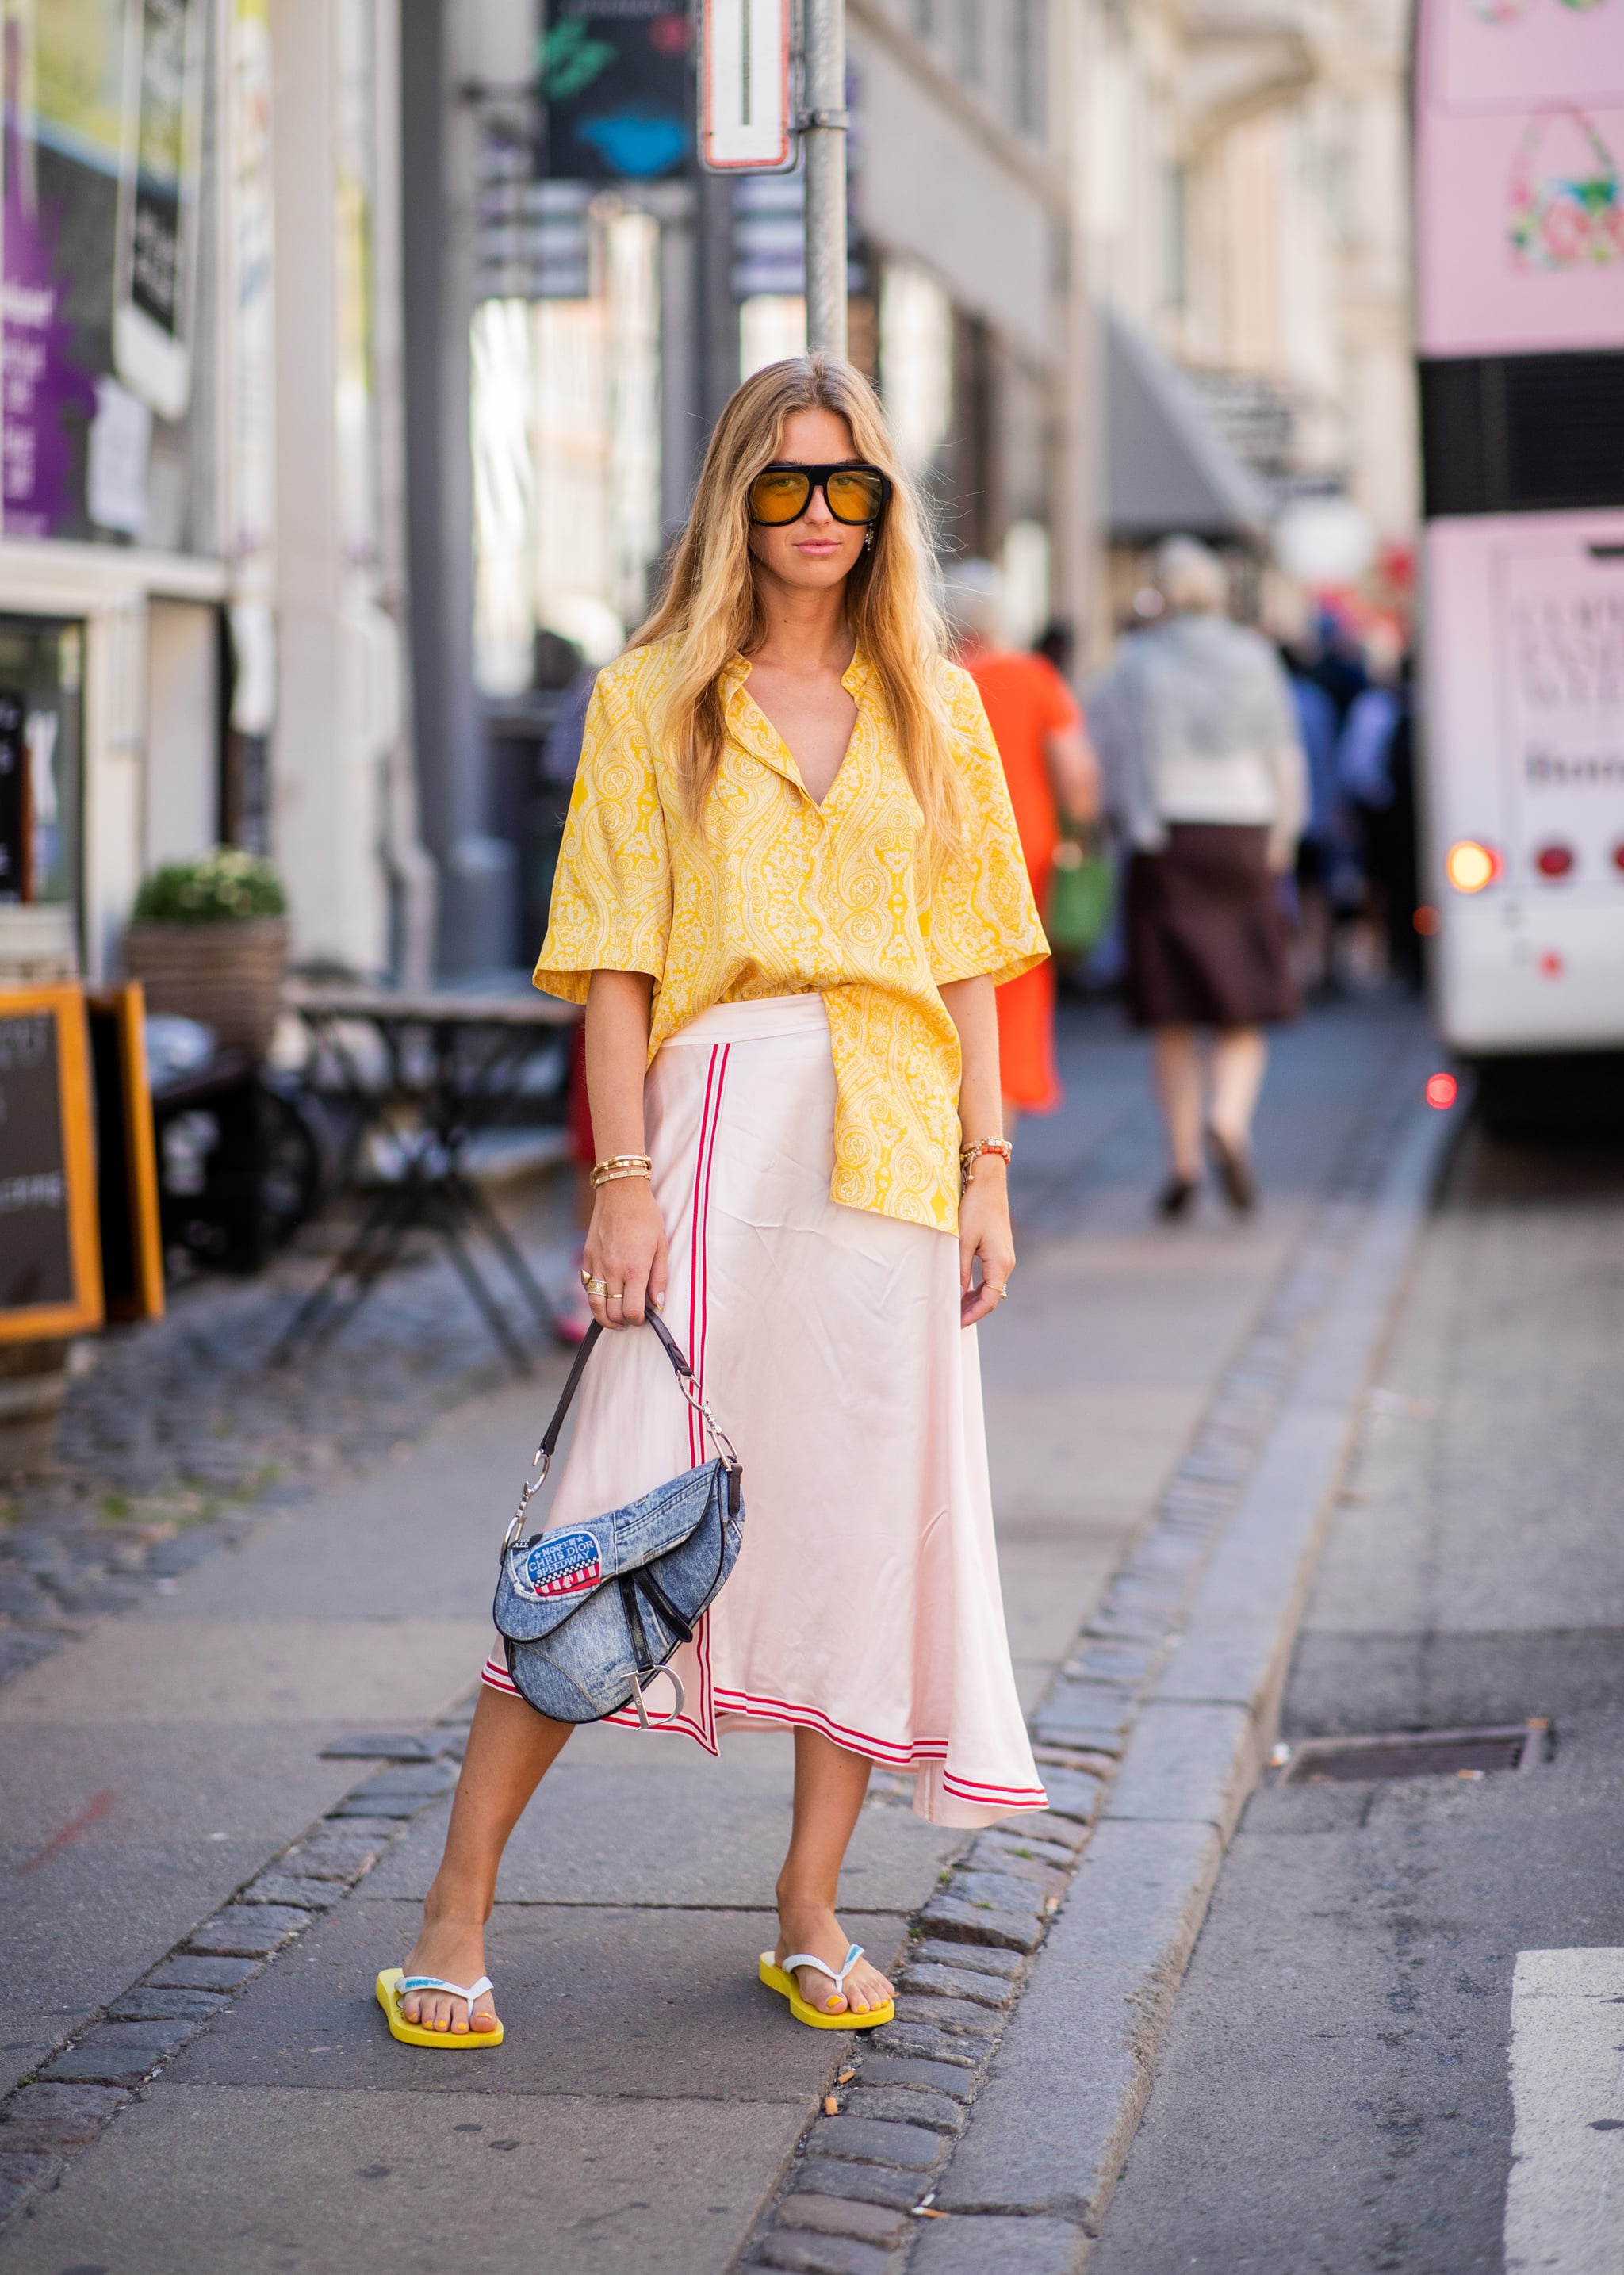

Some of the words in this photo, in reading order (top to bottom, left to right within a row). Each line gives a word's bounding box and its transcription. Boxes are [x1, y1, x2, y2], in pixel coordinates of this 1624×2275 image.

[529, 1551, 565, 1572] CHRIS
[567, 1540, 594, 1557] DIOR
[542, 1538, 577, 1557] NORTH
[536, 1550, 590, 1578] SPEEDWAY
